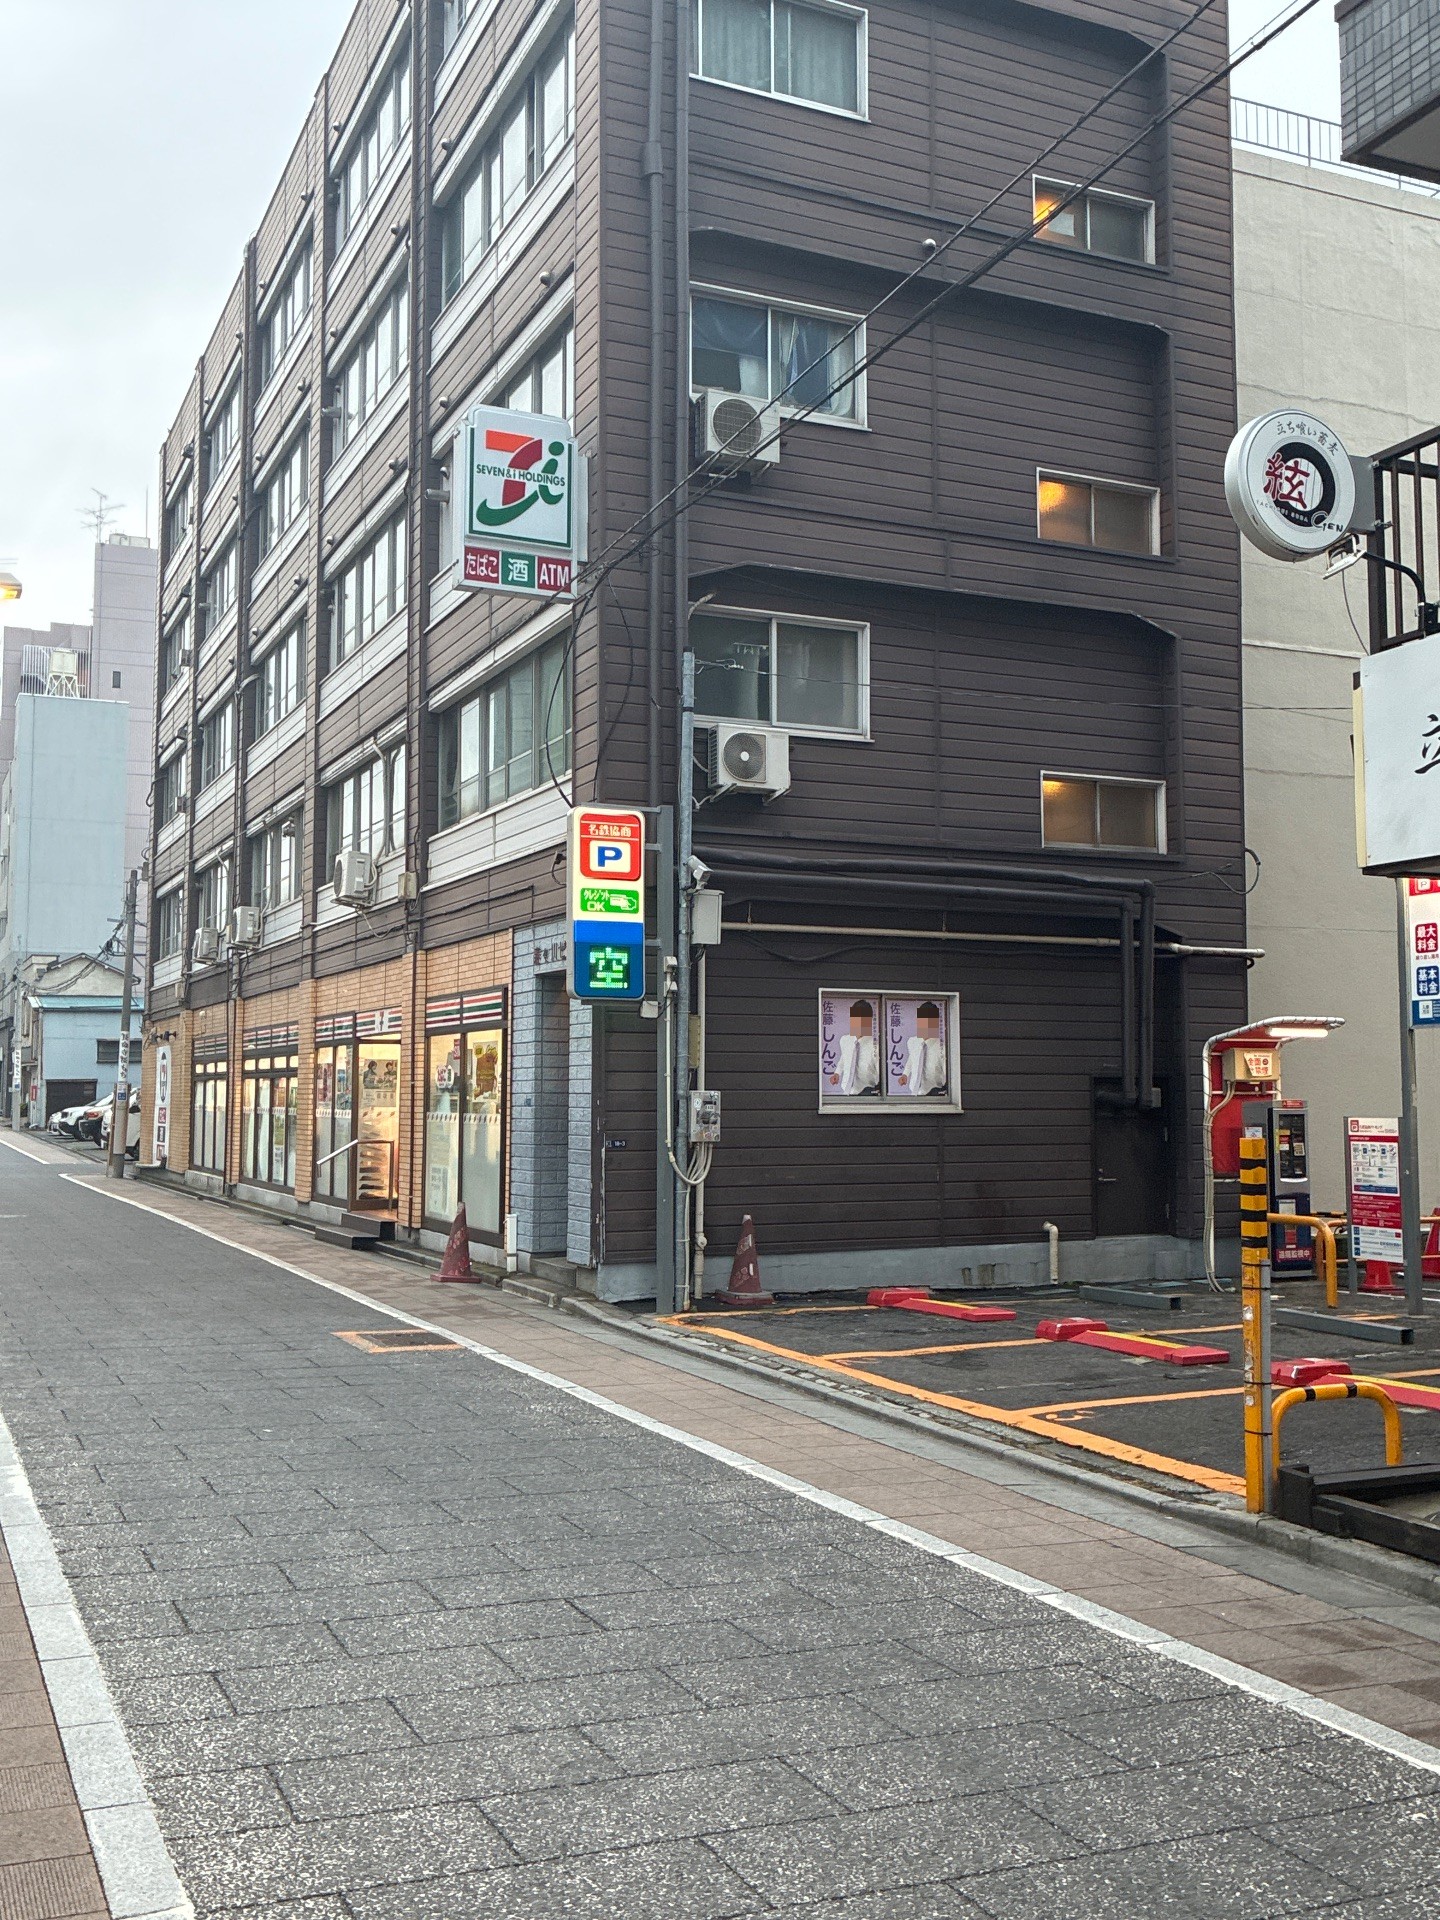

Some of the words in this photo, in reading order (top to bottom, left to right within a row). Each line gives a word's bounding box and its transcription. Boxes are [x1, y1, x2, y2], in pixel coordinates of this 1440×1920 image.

[1276, 421, 1339, 456] 立ち喰い蕎麦
[518, 471, 566, 487] HOLDINGS
[465, 552, 498, 578] たばこ
[507, 557, 529, 582] 酒
[539, 563, 570, 587] ATM
[588, 824, 632, 838] 名鉄協商
[597, 845, 623, 868] P
[583, 889, 610, 902] クレジット
[587, 901, 606, 912] OK
[1416, 925, 1437, 939] 最大
[1416, 939, 1437, 951] 料金
[589, 946, 628, 989] 空
[1418, 968, 1438, 981] 基本
[1418, 982, 1439, 995] 料金
[821, 1000, 837, 1076] 佐藤しんご
[889, 1002, 905, 1077] 佐藤しんご
